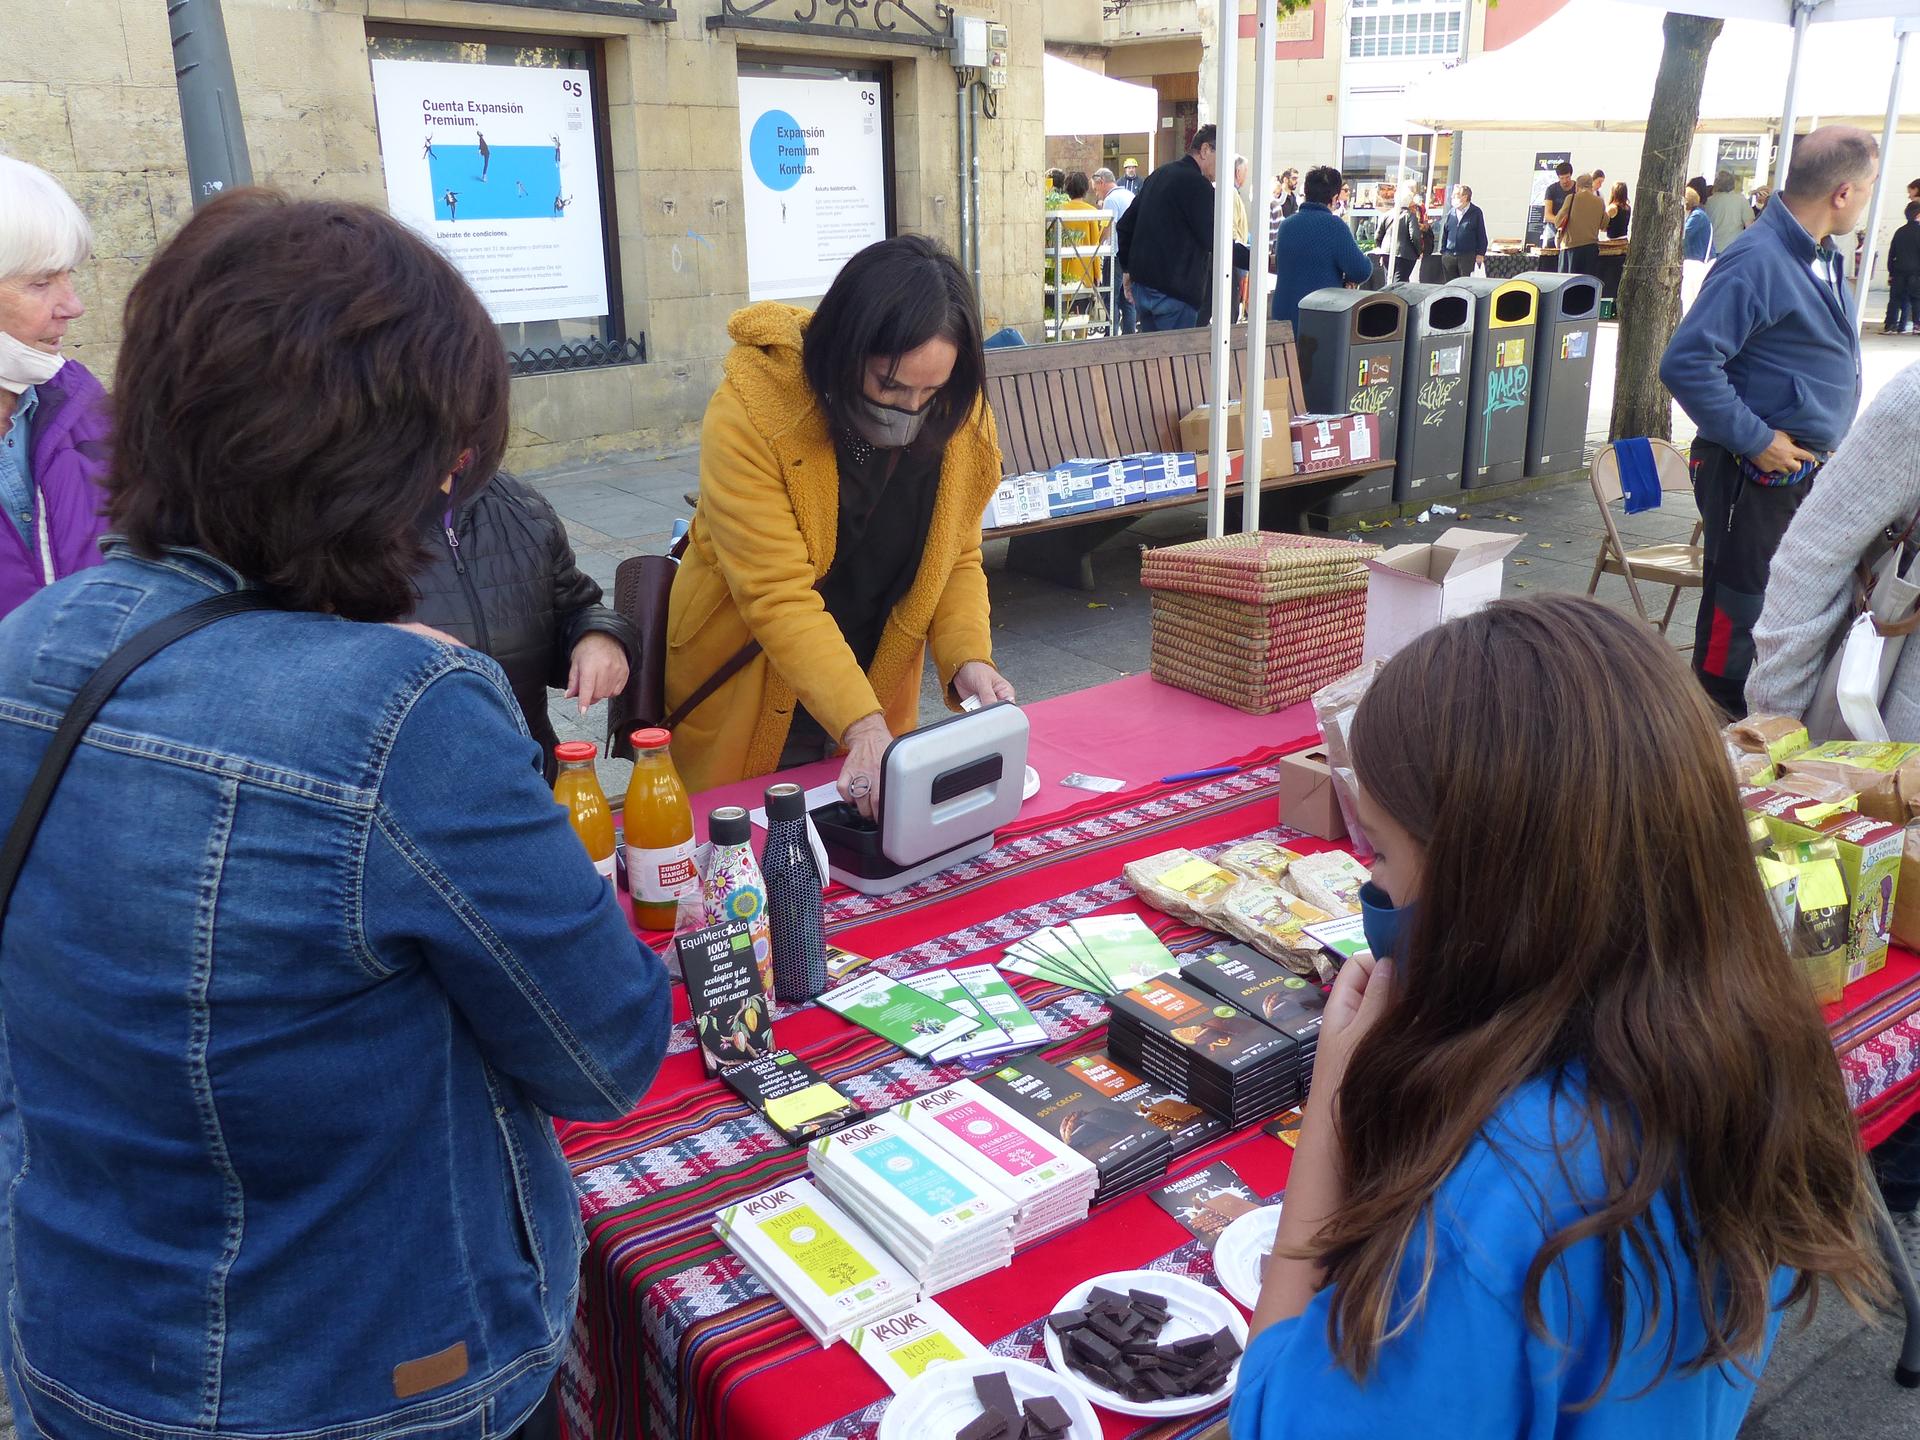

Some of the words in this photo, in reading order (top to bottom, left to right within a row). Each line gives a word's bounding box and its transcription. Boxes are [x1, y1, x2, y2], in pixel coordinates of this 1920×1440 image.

[423, 100, 464, 112] Cuenta
[468, 101, 524, 115] Expansión
[424, 114, 478, 126] Premium.
[777, 127, 825, 140] Expansión
[778, 145, 819, 156] Premium
[779, 164, 815, 175] Kontua.
[661, 864, 681, 873] ZUMO
[661, 869, 684, 879] MANGO
[662, 874, 690, 885] NARANJA
[707, 939, 731, 956] 100%
[710, 951, 729, 961] cacao
[713, 961, 733, 972] Cacao
[705, 971, 733, 986] ecológico
[739, 966, 748, 975] de
[1259, 976, 1284, 988] CACAO
[704, 983, 732, 997] Comercio
[734, 976, 751, 989] Justo
[709, 995, 728, 1007] 100%
[729, 989, 749, 1001] cacao
[751, 1059, 776, 1074] 100%
[769, 1088, 789, 1099] 100%
[916, 1089, 963, 1111] KAOKA
[1055, 1092, 1083, 1108] CACAO
[945, 1106, 977, 1122] NOIR
[836, 1123, 885, 1146] KAOKA
[865, 1142, 898, 1158] NOIR
[1163, 1169, 1211, 1194] ALMENDRAS
[743, 1190, 795, 1216] KAOKA
[770, 1211, 805, 1229] NOIR
[870, 1313, 927, 1342] KAOKA
[902, 1338, 940, 1360] NOIR
